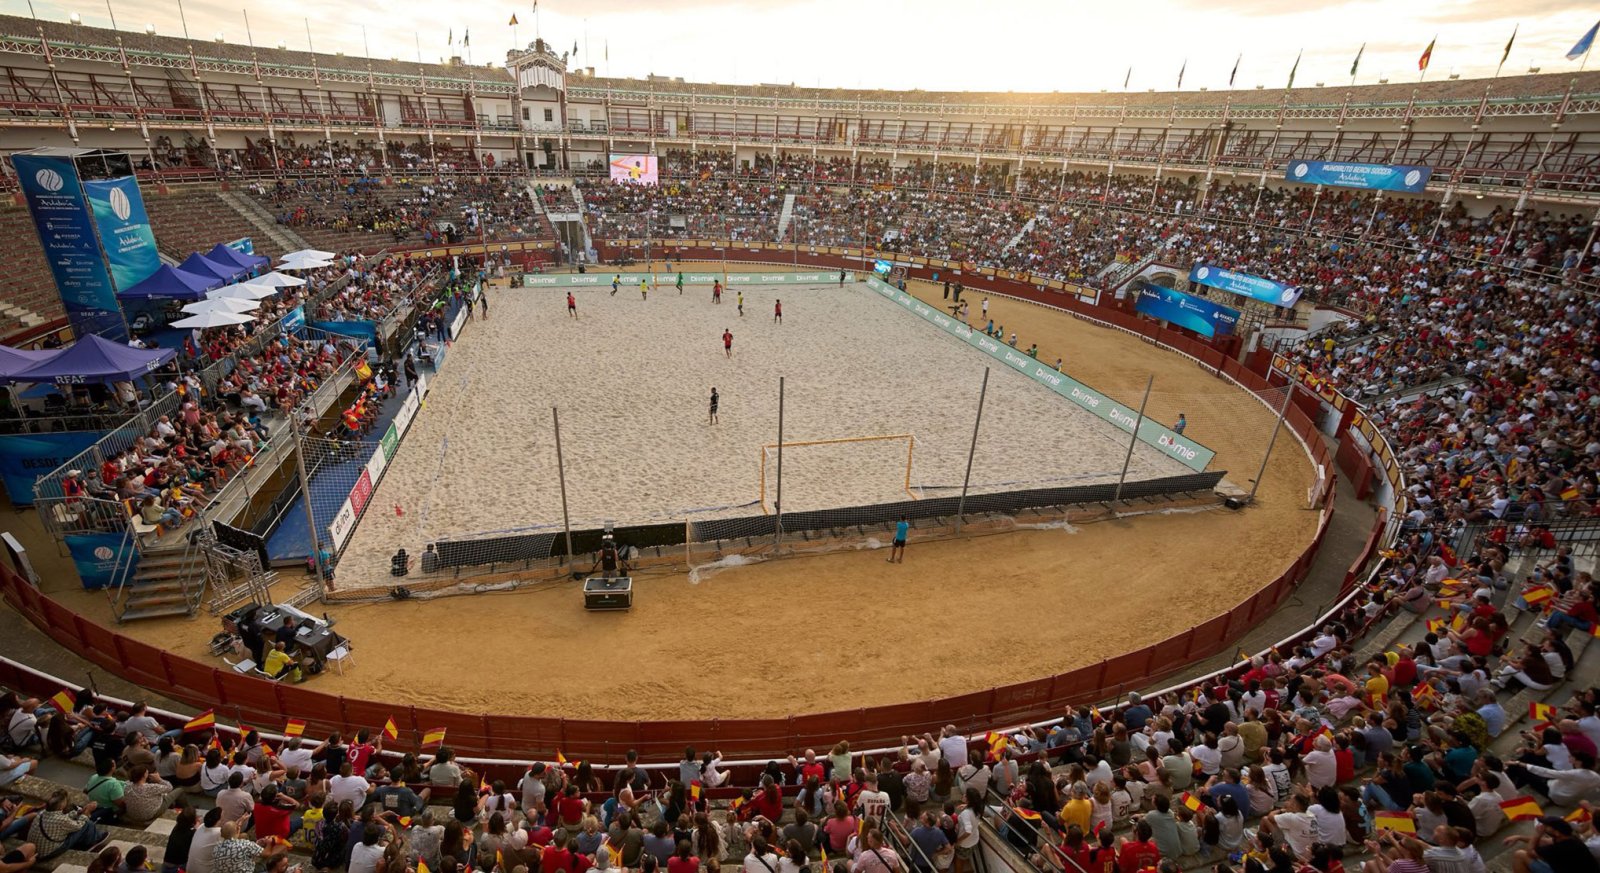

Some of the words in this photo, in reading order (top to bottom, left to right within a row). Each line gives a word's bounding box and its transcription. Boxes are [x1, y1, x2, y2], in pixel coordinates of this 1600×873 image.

[1371, 167, 1392, 175] SOCCER
[55, 375, 87, 384] RFAF
[1072, 388, 1099, 407] biomie
[1158, 433, 1196, 460] biomie
[350, 748, 359, 763] 9
[869, 804, 884, 816] 10
